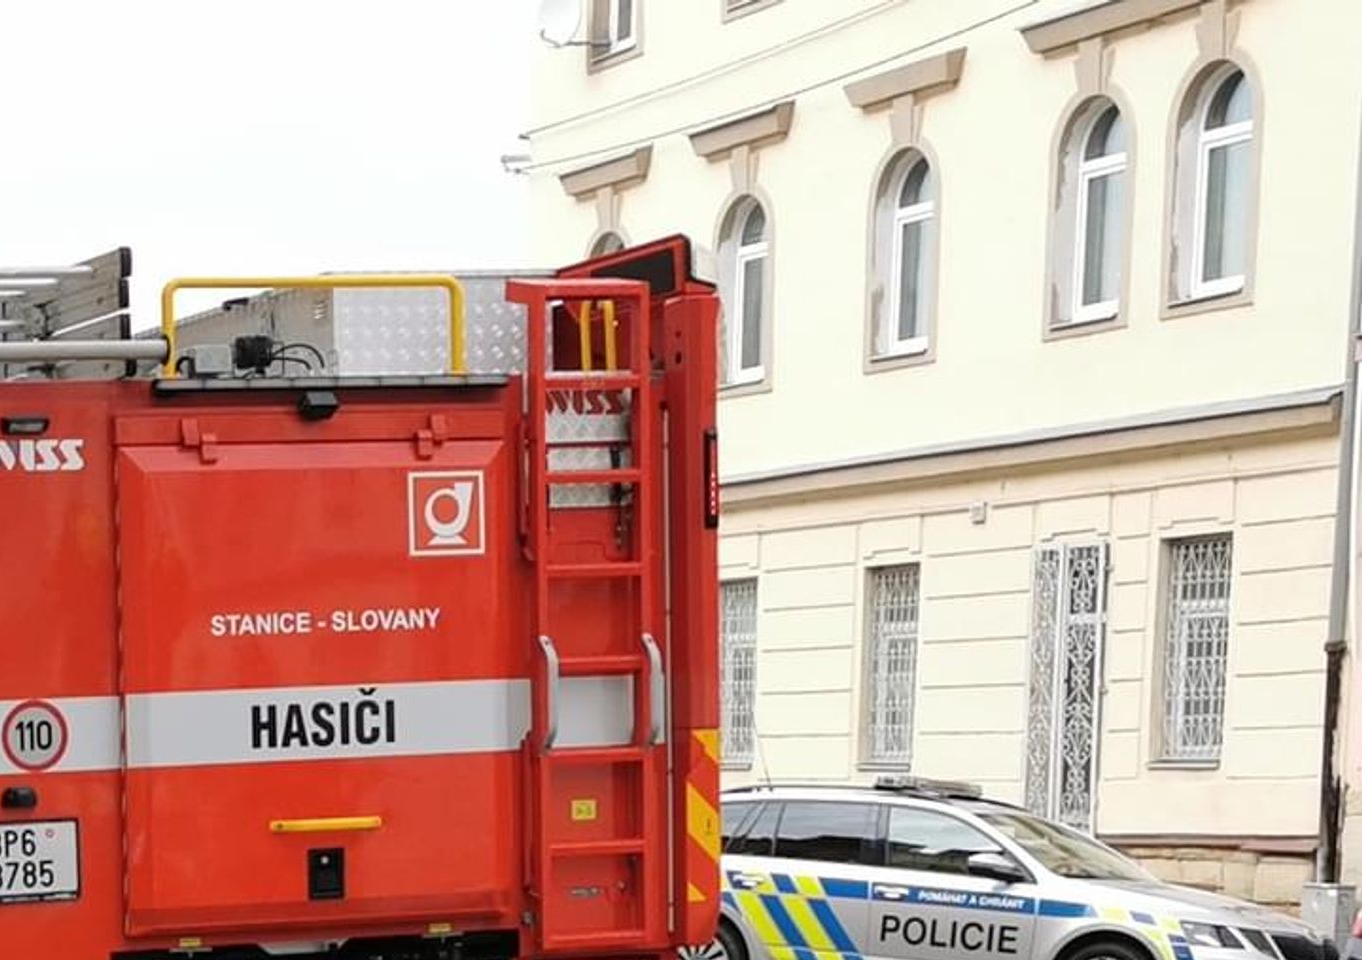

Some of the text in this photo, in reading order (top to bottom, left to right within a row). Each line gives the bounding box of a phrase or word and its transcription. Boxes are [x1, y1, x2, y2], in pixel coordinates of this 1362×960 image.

[211, 612, 312, 635] STANICE
[332, 608, 441, 632] SLOVANY
[15, 720, 52, 752] 110
[251, 687, 396, 749] HASIČI
[879, 914, 1020, 954] POLICIE
